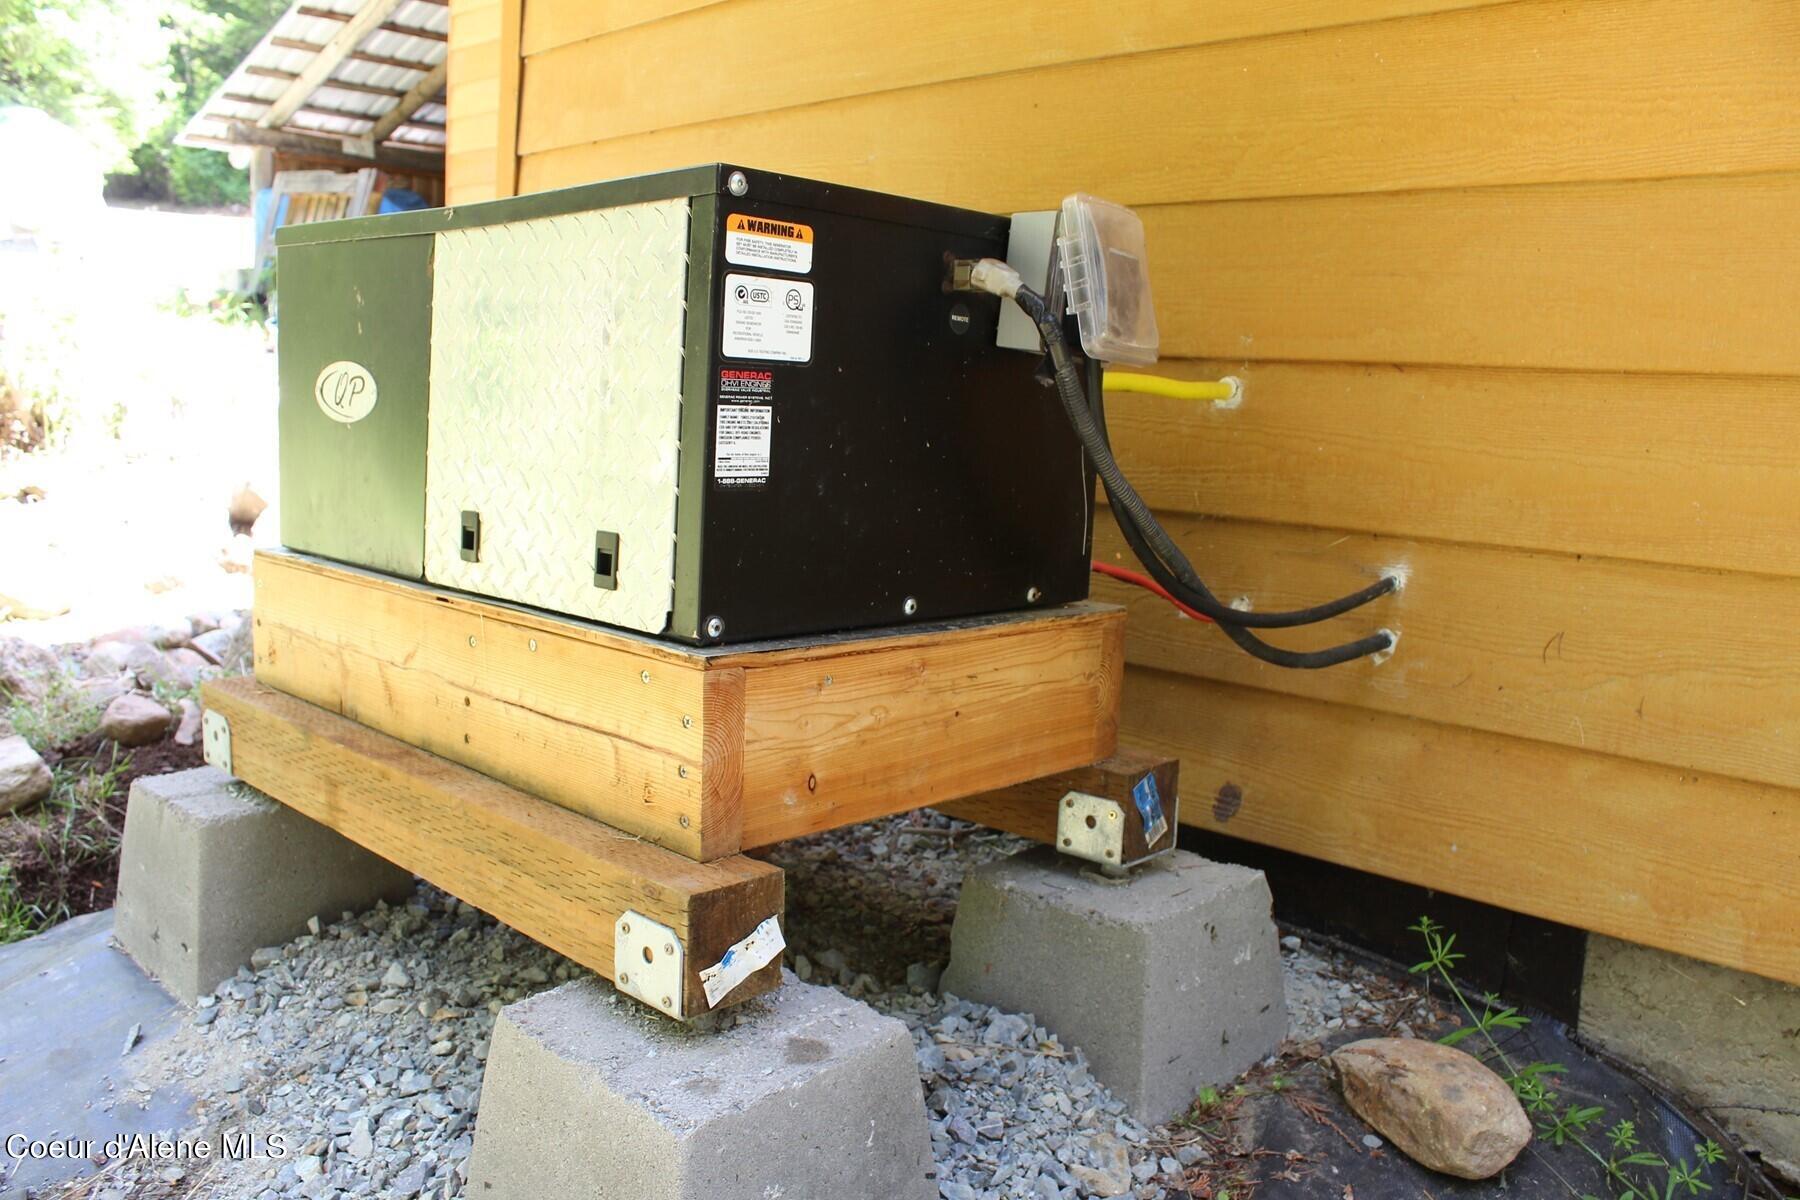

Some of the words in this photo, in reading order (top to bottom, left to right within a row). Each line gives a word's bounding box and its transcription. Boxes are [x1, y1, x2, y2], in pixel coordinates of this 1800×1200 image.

[747, 219, 794, 238] WARNING
[753, 291, 767, 300] USTC
[721, 370, 772, 380] GENERAC
